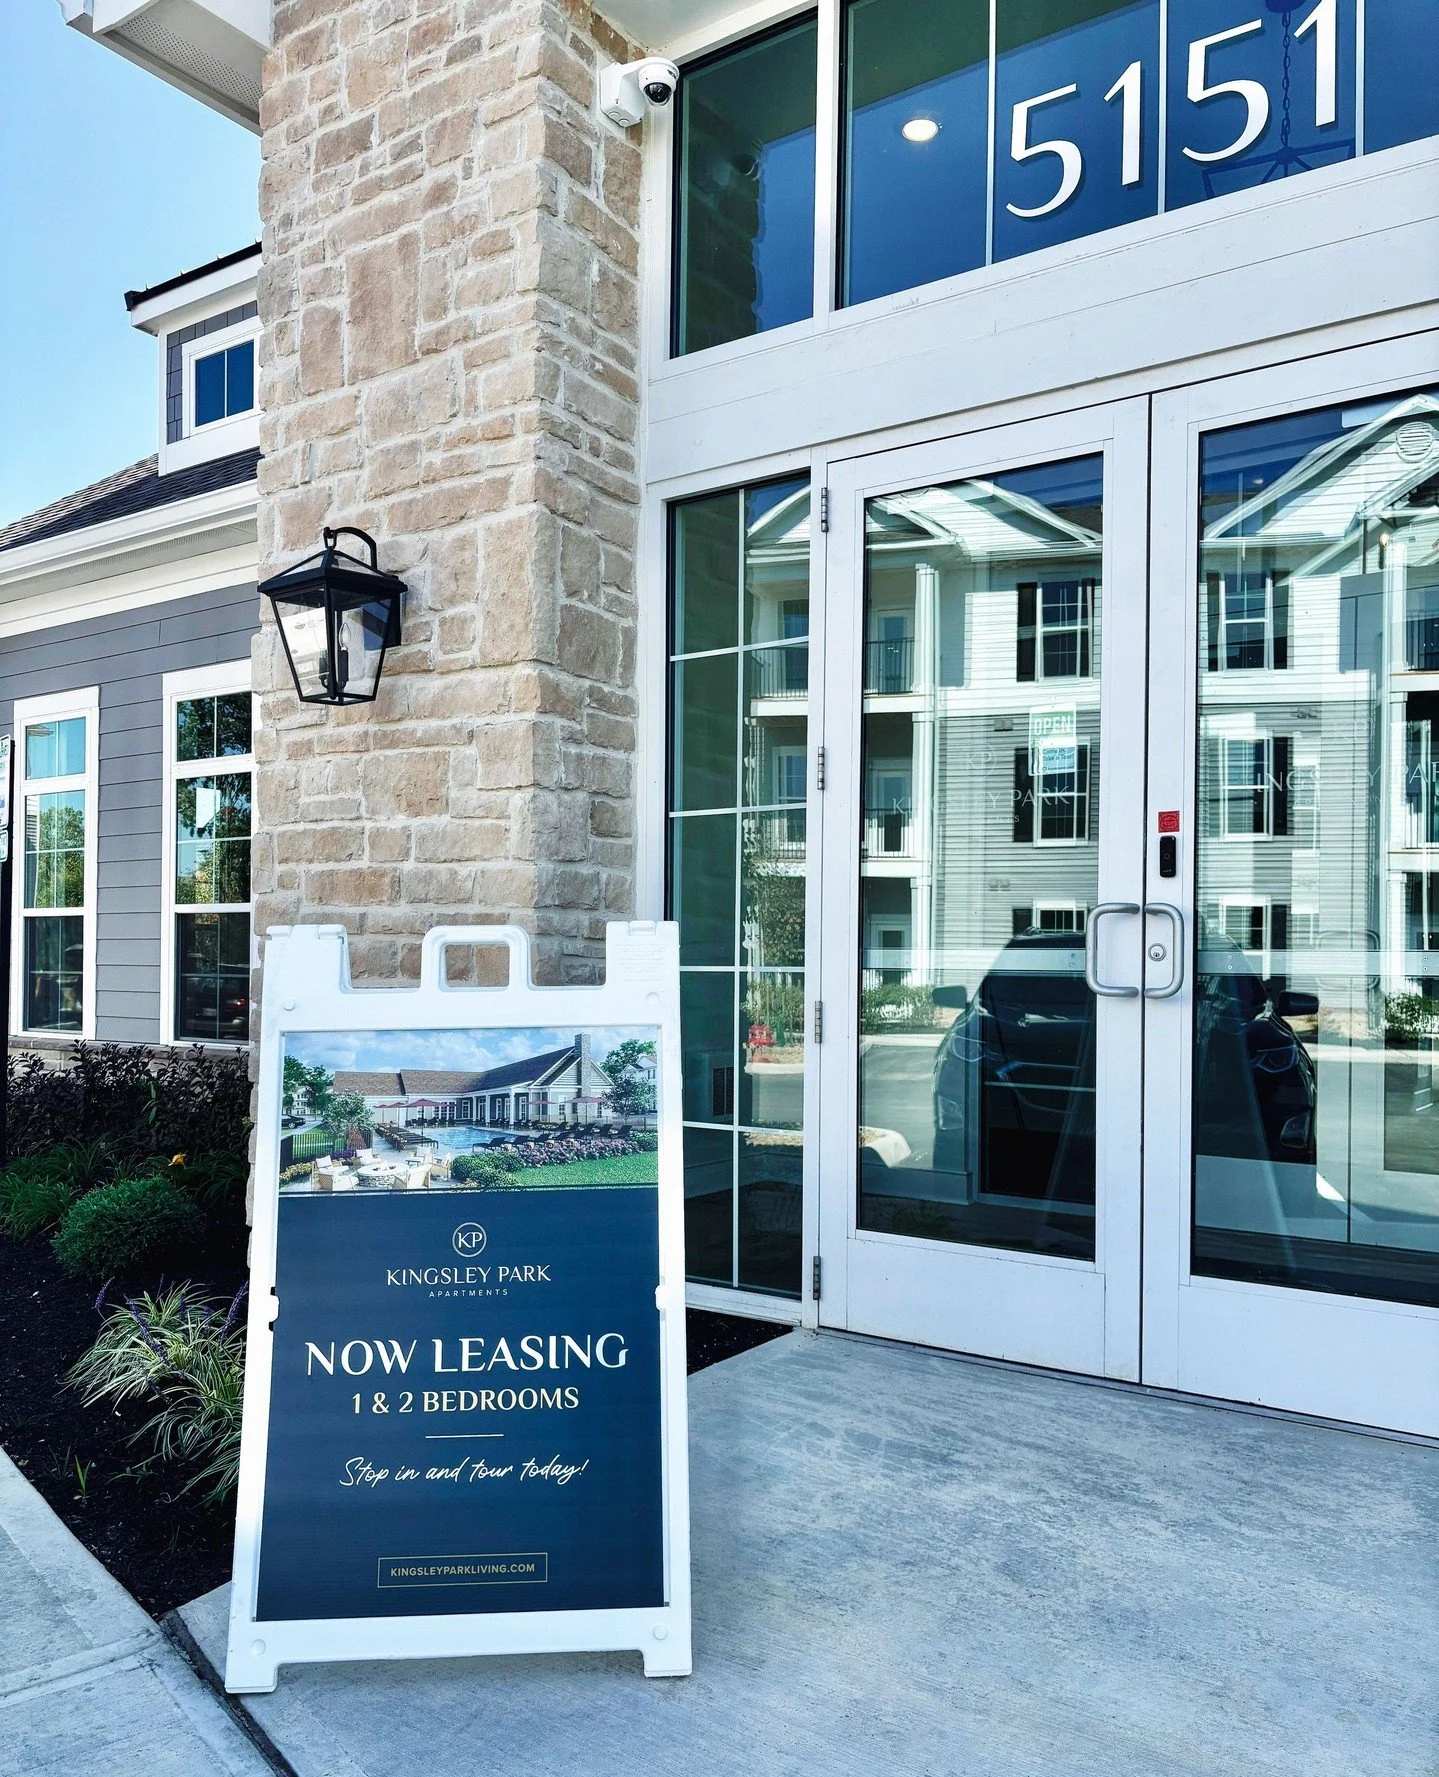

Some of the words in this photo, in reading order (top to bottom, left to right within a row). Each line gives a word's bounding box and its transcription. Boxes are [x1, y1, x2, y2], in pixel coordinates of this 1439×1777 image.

[1005, 0, 1337, 218] 5151
[1034, 715, 1071, 735] OPEN
[1009, 785, 1071, 808] PARK
[457, 1231, 483, 1249] KP
[386, 1266, 492, 1286] KINGSLEY
[498, 1264, 552, 1283] PARK
[428, 1288, 509, 1298] APARTMENTS
[304, 1339, 418, 1376] NOW
[431, 1332, 629, 1374] LEASING
[352, 1392, 361, 1414] 1
[371, 1391, 389, 1413] &
[399, 1391, 413, 1413] 2
[422, 1386, 579, 1413] BEDROOMS
[339, 1456, 389, 1488] Stop
[394, 1464, 421, 1482] in
[425, 1455, 471, 1482] and
[469, 1458, 514, 1483] tour
[519, 1453, 590, 1486] today!
[390, 1563, 536, 1578] KINGSLEYPARKLIVING.COM
